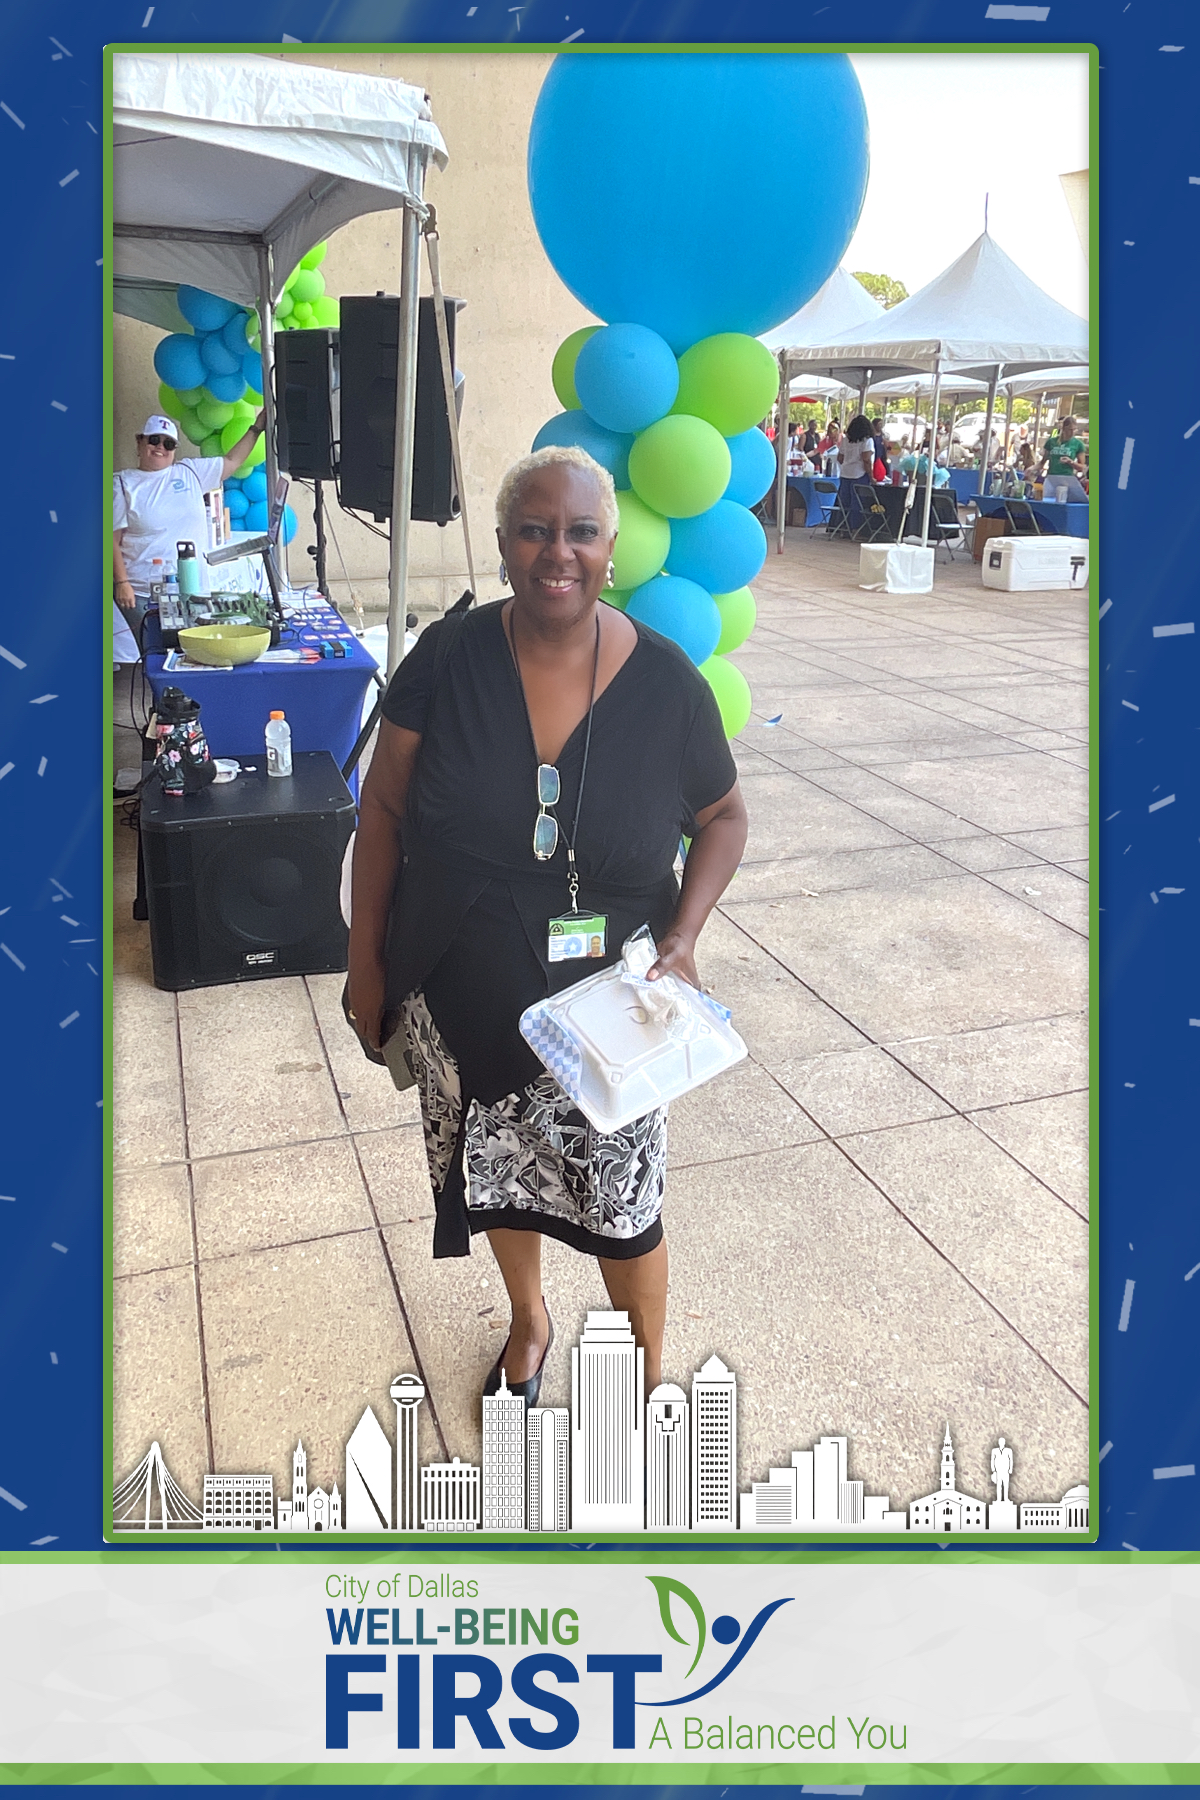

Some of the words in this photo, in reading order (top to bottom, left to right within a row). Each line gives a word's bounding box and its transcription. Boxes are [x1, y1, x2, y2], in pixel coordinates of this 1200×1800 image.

[159, 420, 170, 430] T
[153, 585, 161, 594] G
[267, 748, 276, 760] G
[246, 952, 275, 961] QSC
